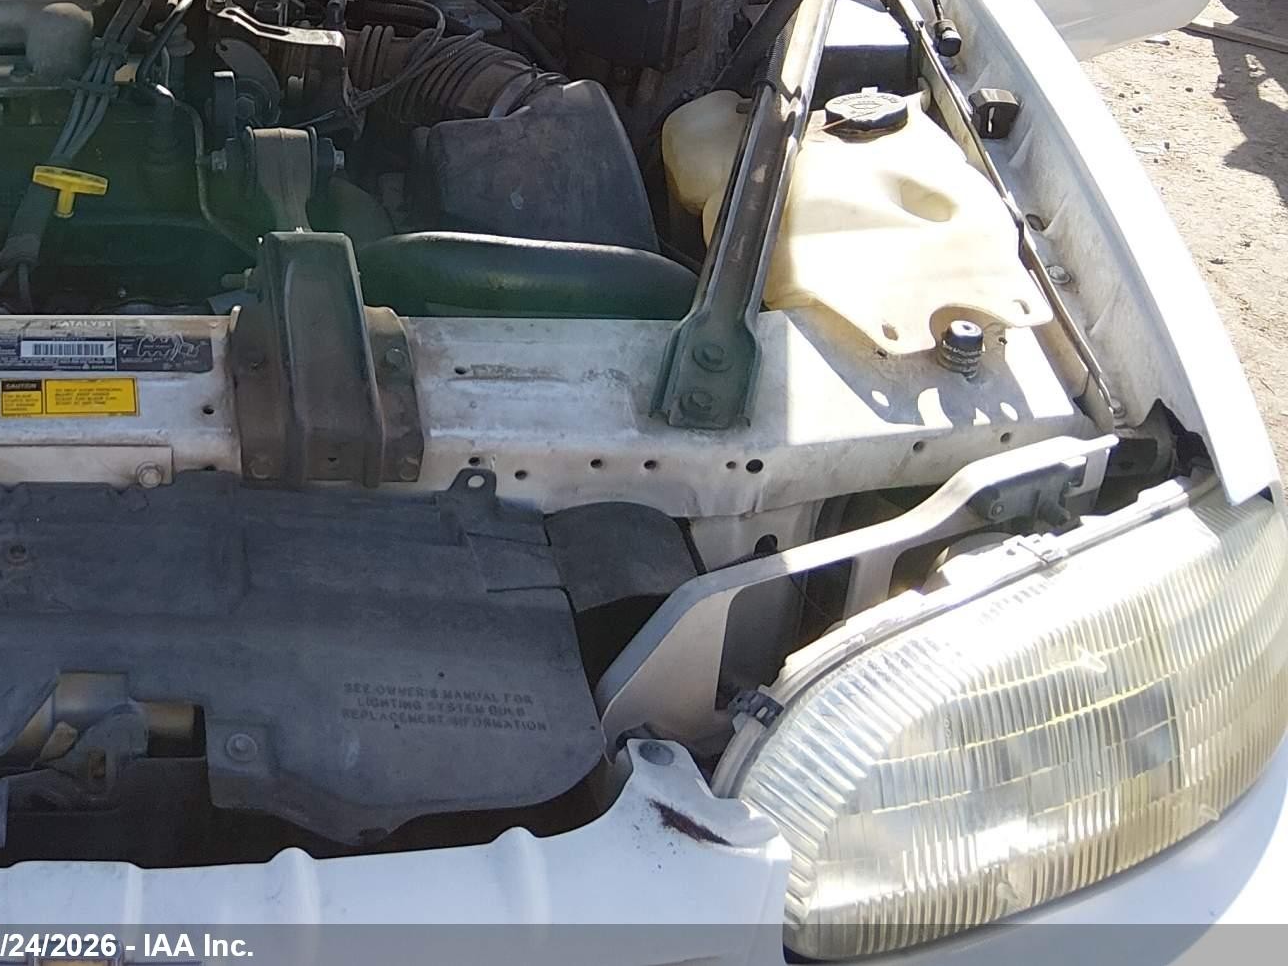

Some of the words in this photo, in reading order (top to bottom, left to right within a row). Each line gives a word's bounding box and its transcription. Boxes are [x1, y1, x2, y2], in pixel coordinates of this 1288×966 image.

[343, 681, 370, 695] SEE
[375, 683, 439, 699] OWNER'S
[442, 689, 499, 703] MANUAL
[503, 693, 534, 706] FOR
[357, 697, 423, 712] LIGHTING
[426, 701, 486, 715] SYSTEM
[341, 708, 444, 725] REPLACEMENT
[448, 715, 547, 731] INFORMATION
